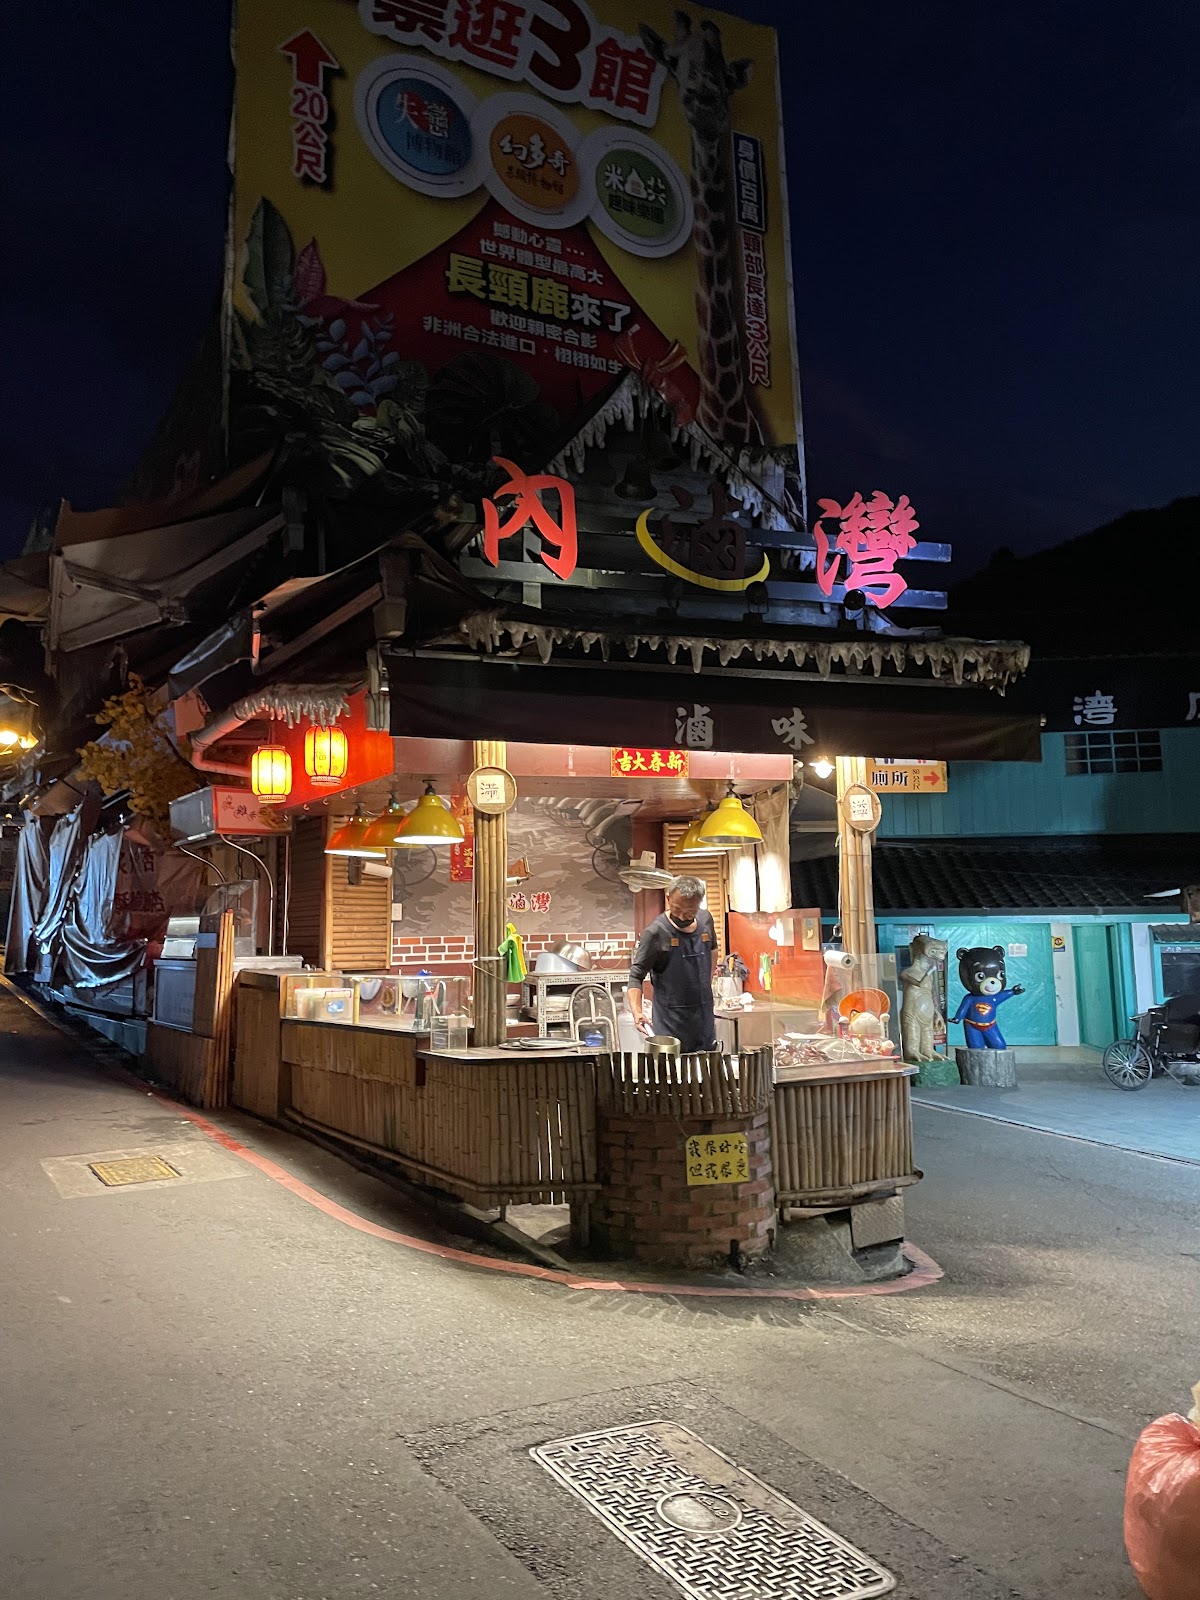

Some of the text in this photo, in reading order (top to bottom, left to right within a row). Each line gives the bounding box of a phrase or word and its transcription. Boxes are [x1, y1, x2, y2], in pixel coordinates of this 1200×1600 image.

[292, 87, 325, 180] 20公尺
[479, 238, 604, 286] 世界體型最高大
[445, 251, 631, 333] 長頸鹿來了
[742, 230, 770, 386] 頸部長達3公尺
[490, 308, 598, 349] 歡迎親密合影
[675, 703, 815, 749] 滷味
[871, 770, 909, 787] 廁所
